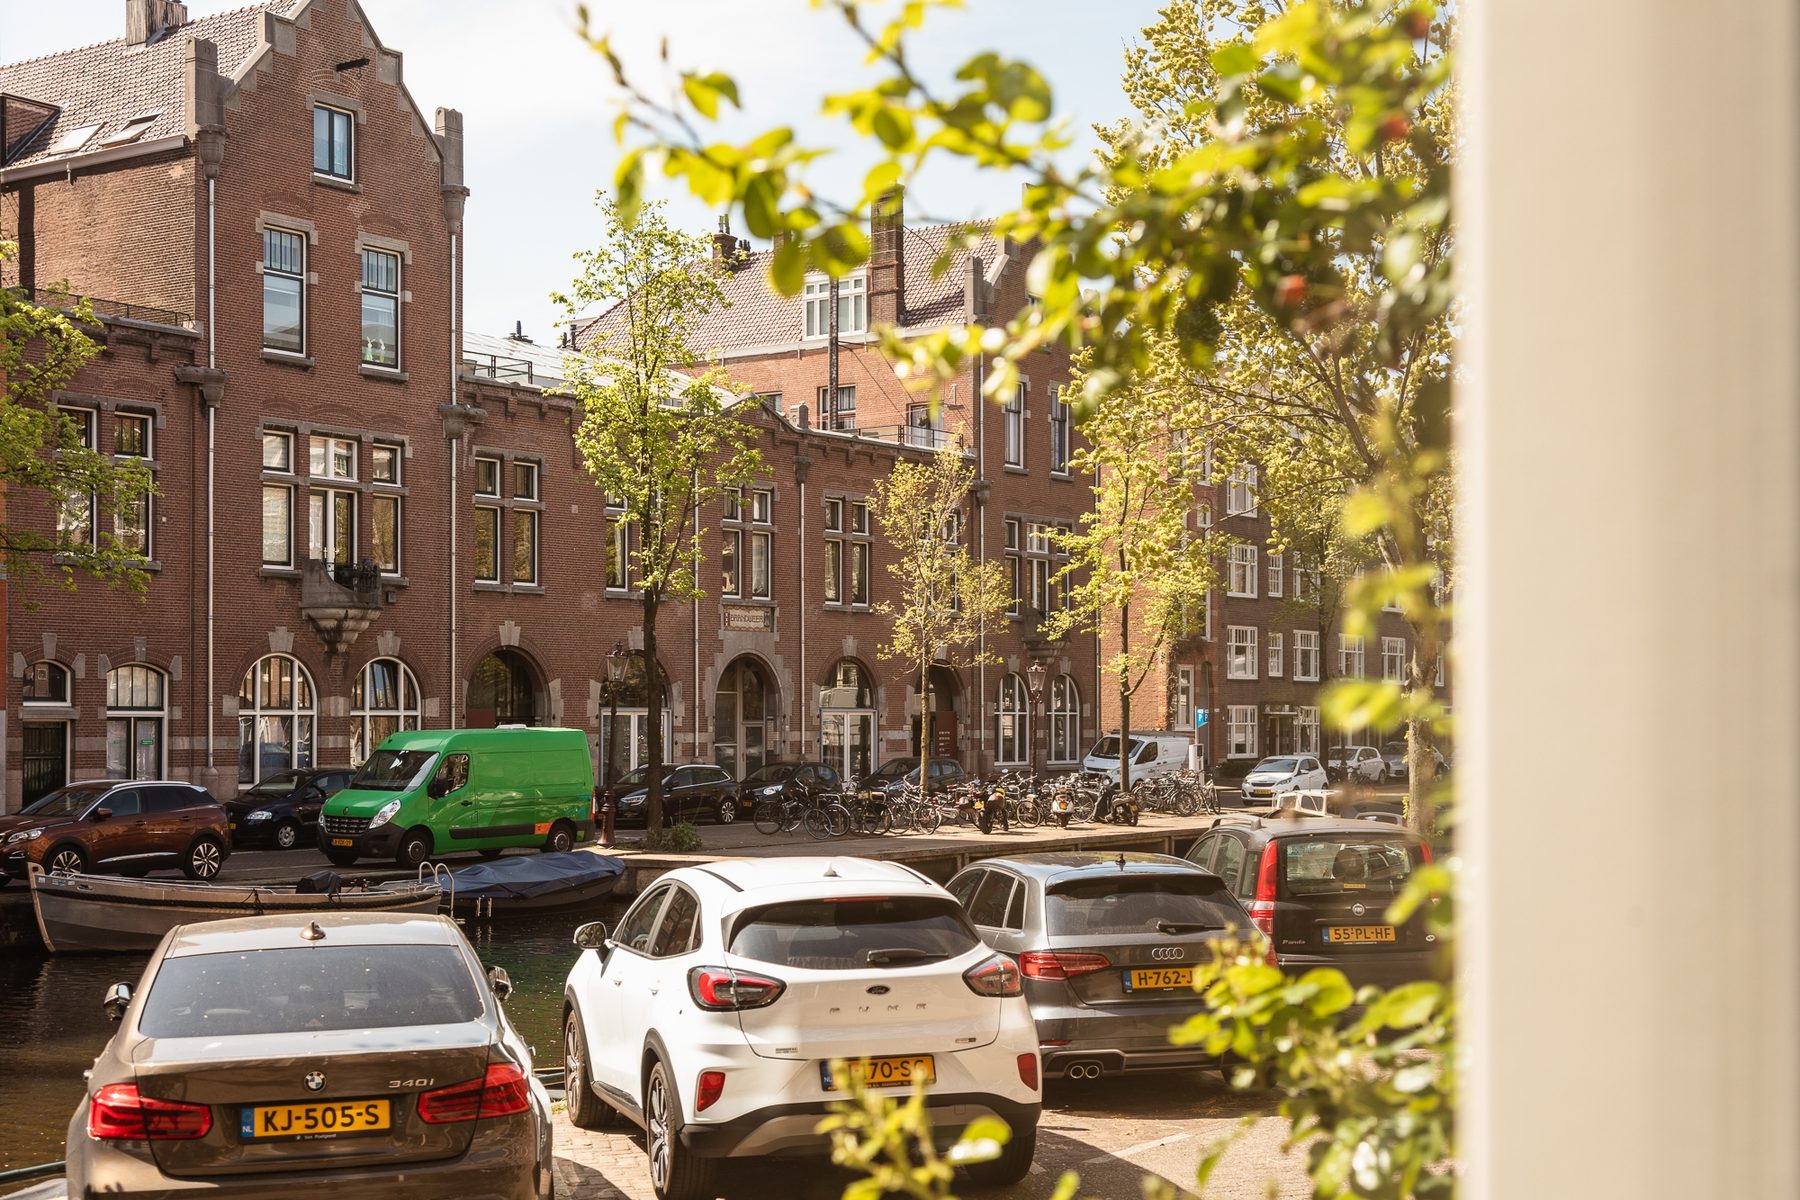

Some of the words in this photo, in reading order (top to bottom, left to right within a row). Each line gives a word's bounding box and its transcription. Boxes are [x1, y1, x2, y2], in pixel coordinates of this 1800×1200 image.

[1334, 927, 1391, 940] 55-PL-HF
[1137, 970, 1194, 986] H-762-J
[263, 1104, 380, 1133] KJ-505-S
[242, 1125, 253, 1133] NL
